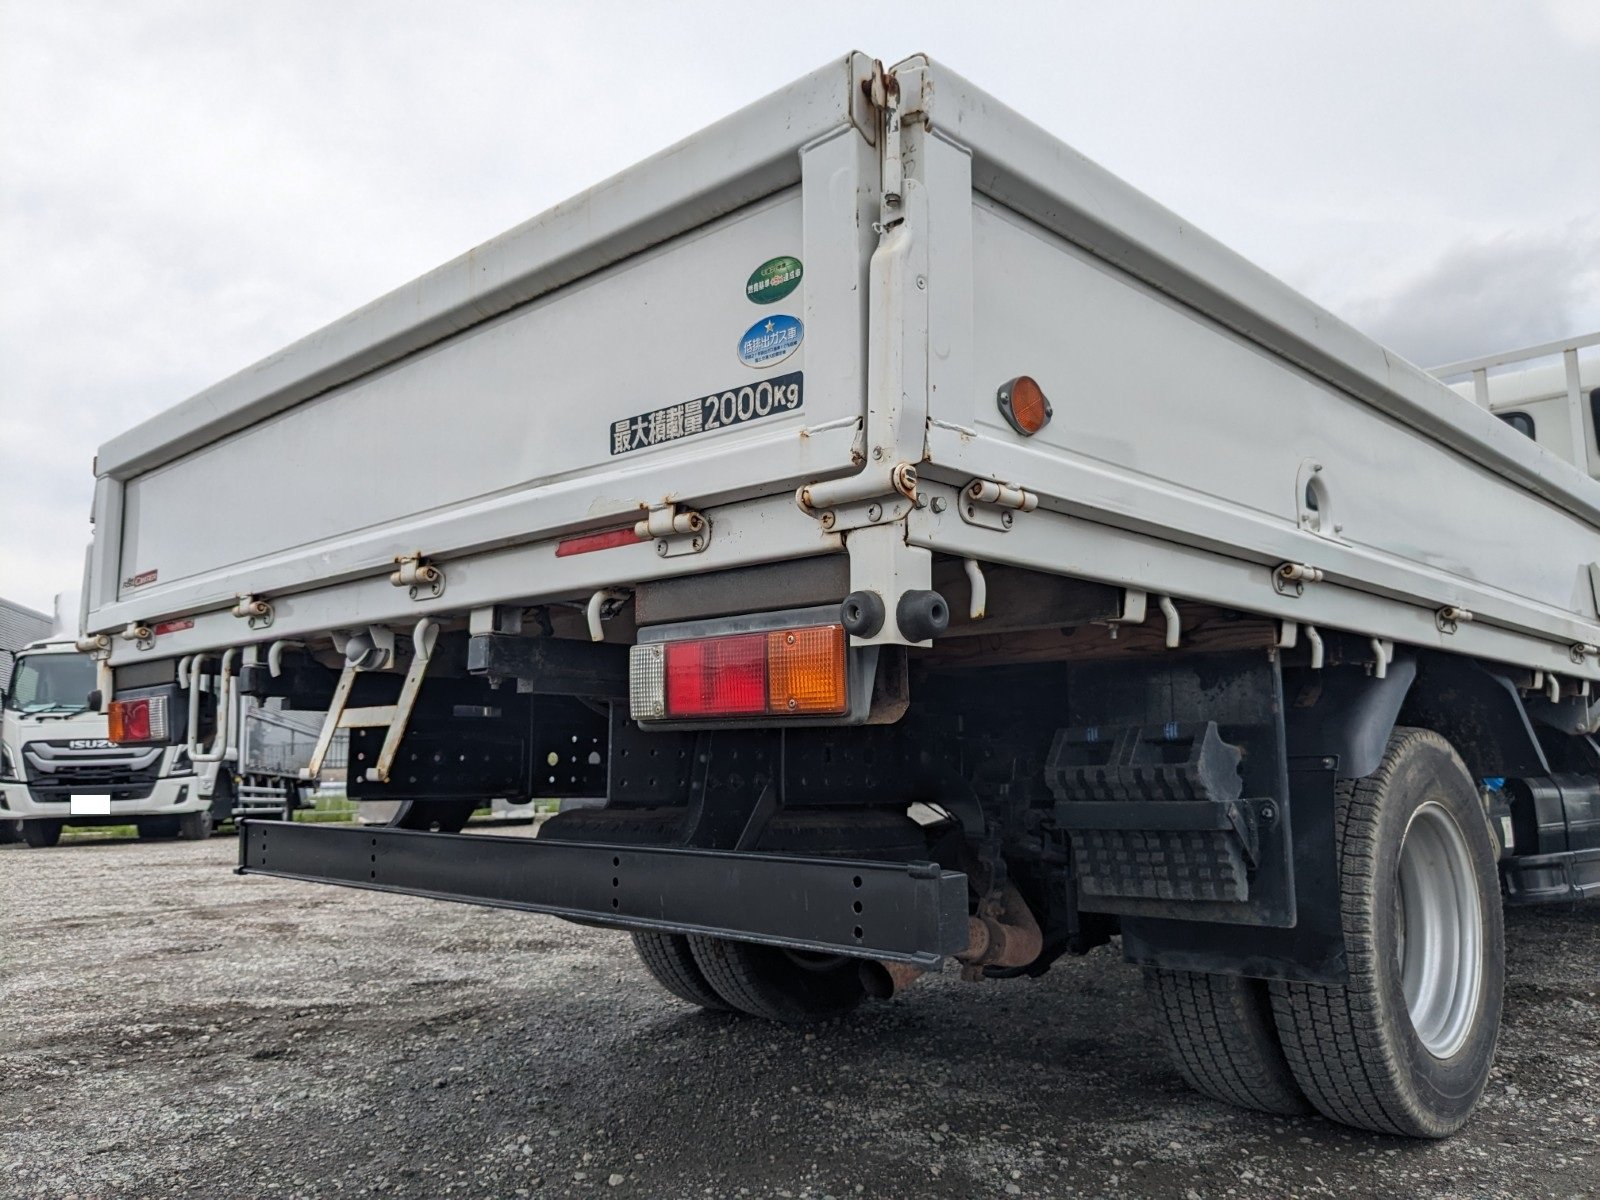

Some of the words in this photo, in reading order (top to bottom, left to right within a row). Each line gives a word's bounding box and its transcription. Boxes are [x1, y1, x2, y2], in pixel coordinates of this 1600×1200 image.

[744, 326, 797, 354] 低排出ガス車
